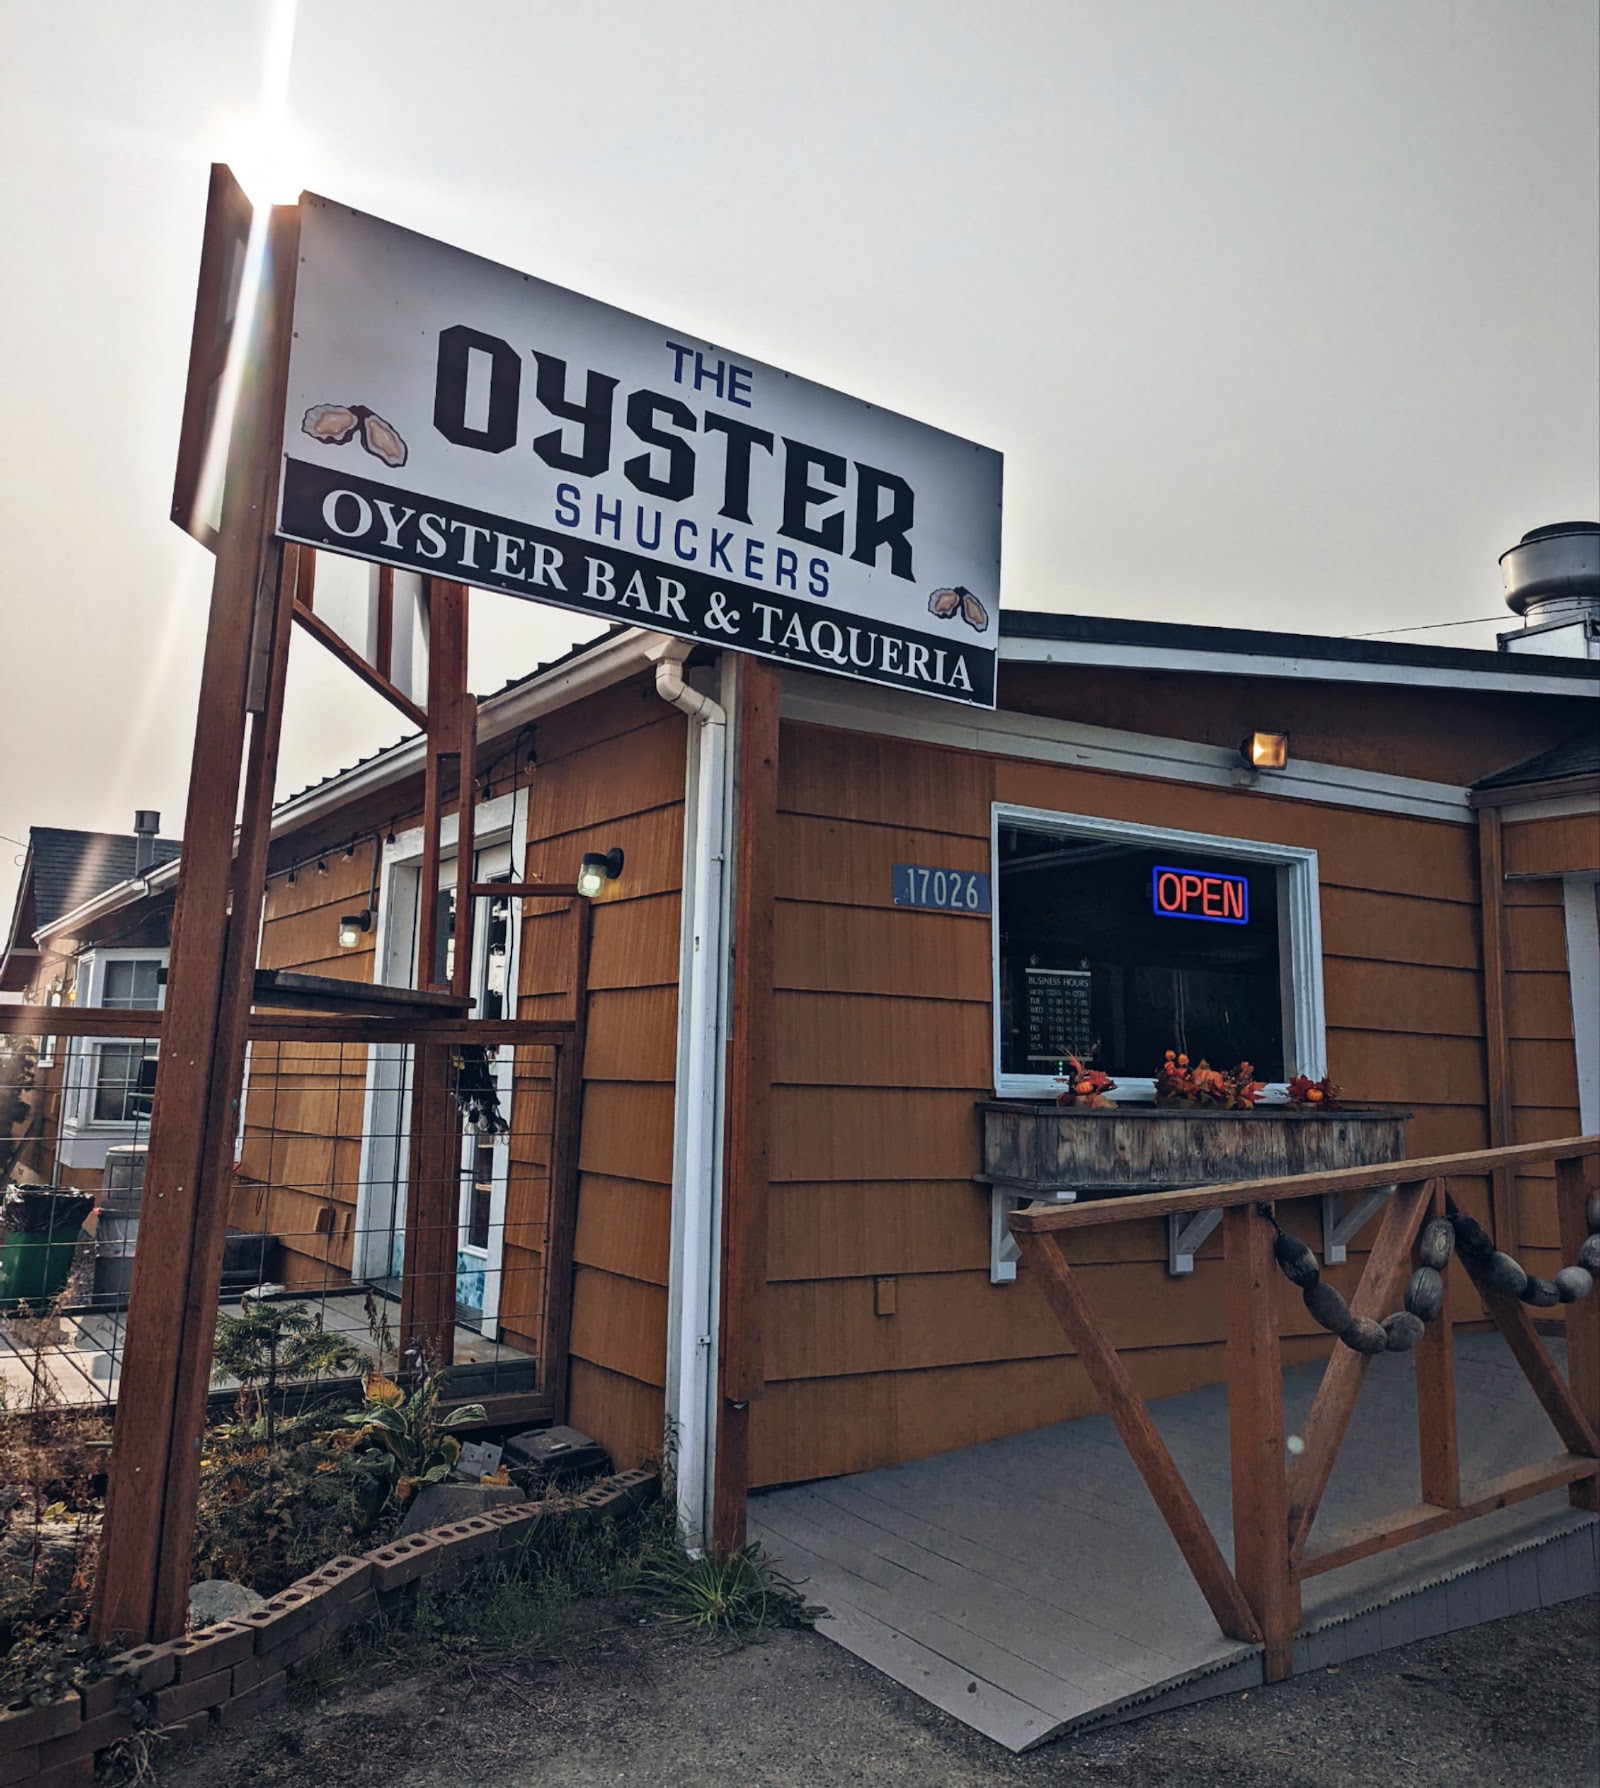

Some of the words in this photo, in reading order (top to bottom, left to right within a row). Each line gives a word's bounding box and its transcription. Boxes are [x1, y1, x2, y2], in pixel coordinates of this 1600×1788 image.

[666, 341, 752, 408] THE
[433, 324, 916, 583] OYSTER
[555, 483, 829, 598] SHUCKERS
[322, 490, 567, 592] OYSTER
[583, 556, 690, 623] BAR
[704, 591, 740, 635] &
[752, 602, 973, 692] TAQUERIA
[907, 868, 979, 909] 17026
[1158, 873, 1243, 918] OPEN
[1028, 976, 1061, 986] BUSINESS
[1063, 978, 1089, 987] HOURS
[1030, 997, 1040, 1005] TUE
